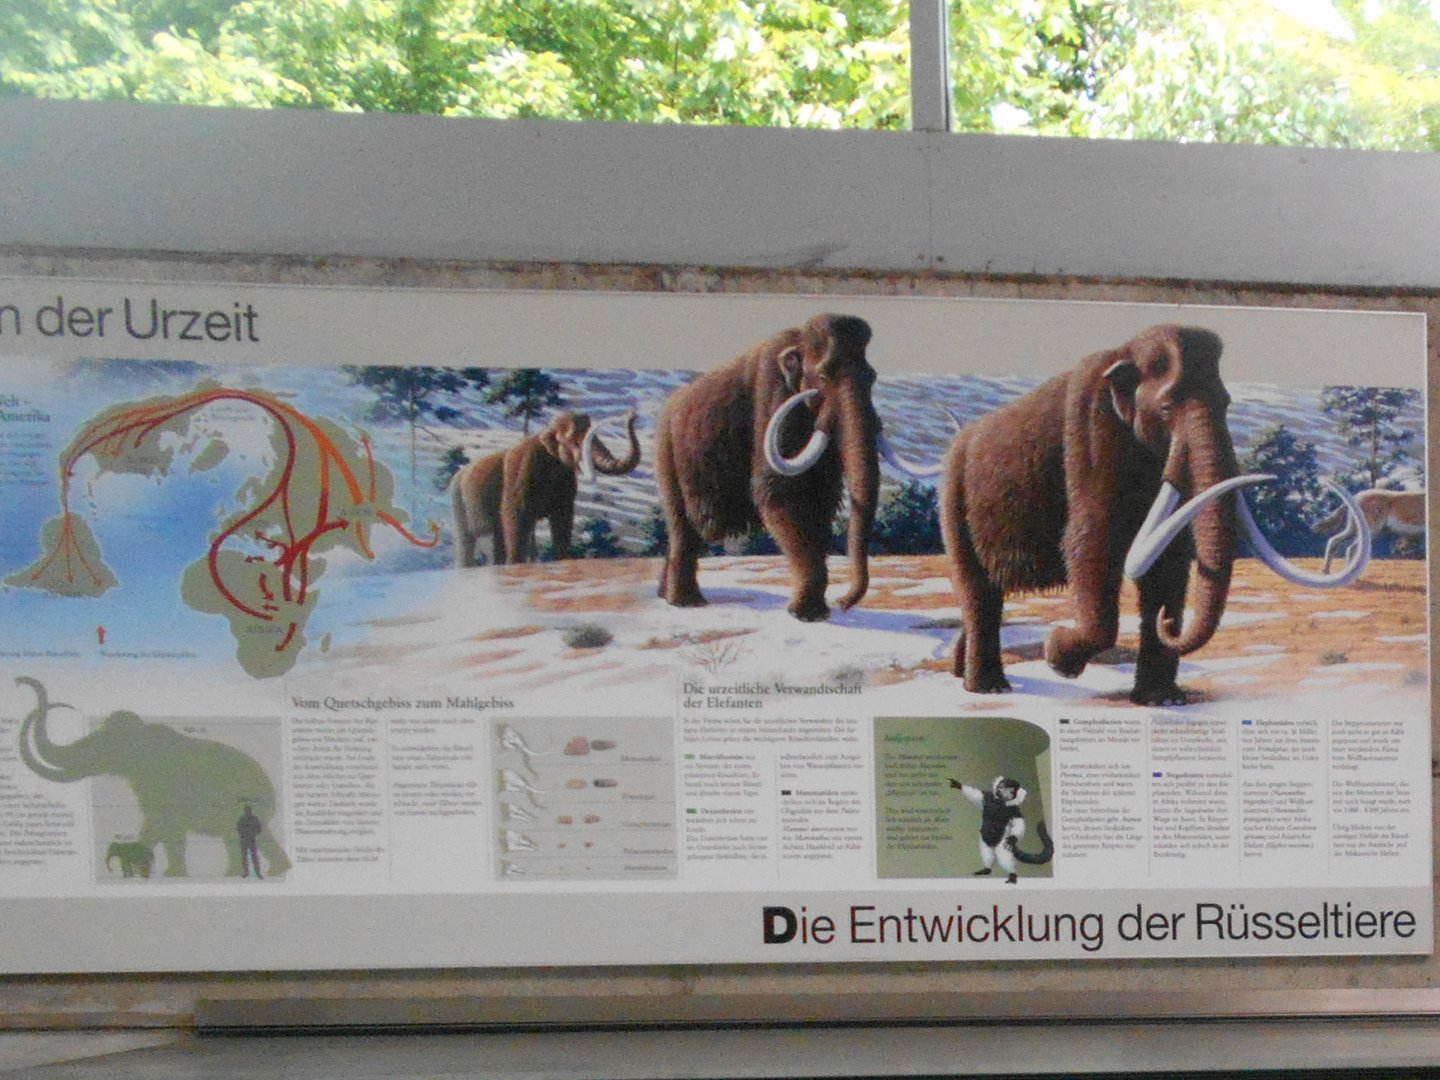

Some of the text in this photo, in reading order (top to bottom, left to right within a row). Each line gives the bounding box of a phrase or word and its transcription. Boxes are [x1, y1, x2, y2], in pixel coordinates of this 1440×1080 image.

[0, 296, 260, 342] n der Urzeit
[682, 682, 863, 696] Die urzeitliche Verwandtschaft
[291, 696, 515, 713] Vom Quetschgebiss zum Mahlgebiss
[683, 696, 764, 709] der Elefanten
[763, 901, 1417, 951] Die Entwicklung der Rüsseltiere
